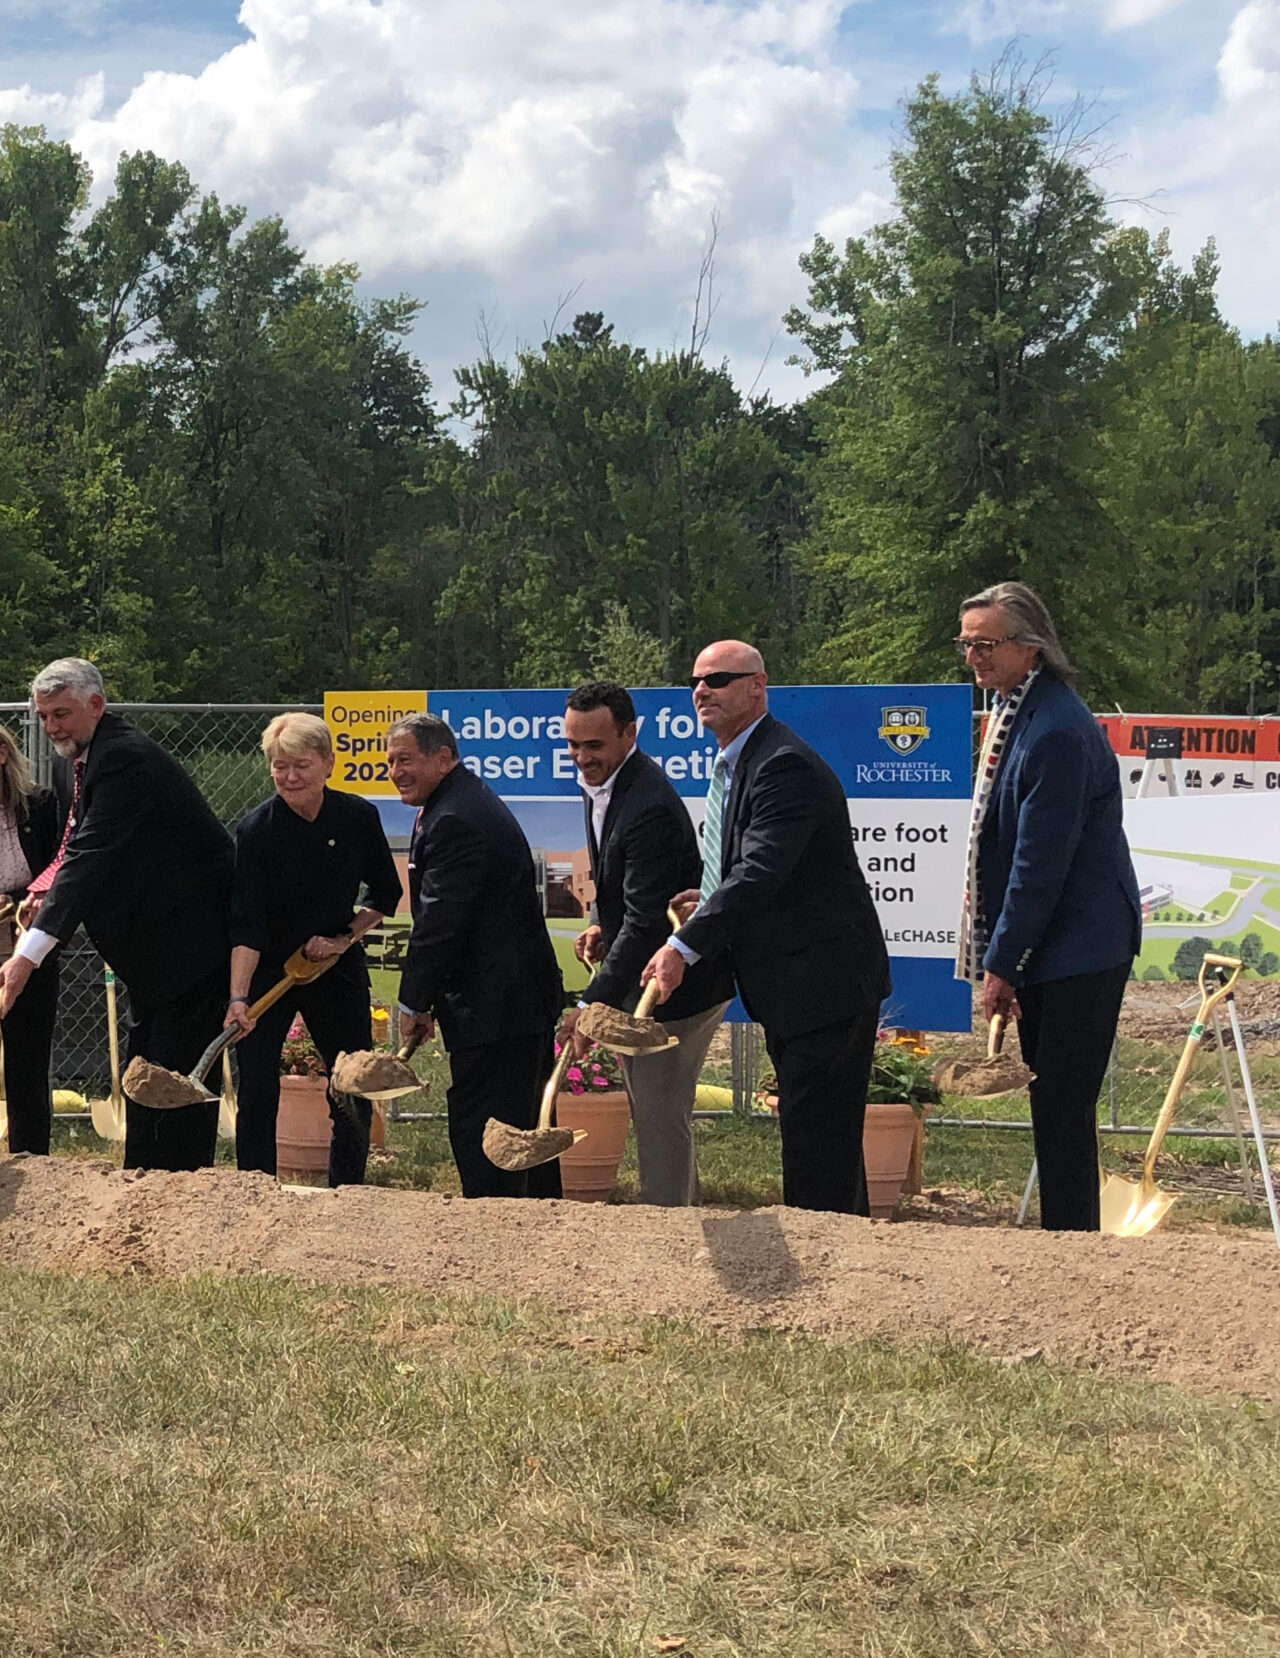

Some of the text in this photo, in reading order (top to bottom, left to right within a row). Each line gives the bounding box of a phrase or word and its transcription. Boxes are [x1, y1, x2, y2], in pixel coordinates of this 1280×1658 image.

[442, 709, 645, 740] Labora
[336, 732, 388, 757] Spri
[1130, 726, 1257, 755] ANTION
[344, 762, 389, 782] 202
[463, 755, 540, 779] aser
[856, 764, 952, 783] ROCHESTER
[895, 822, 948, 843] foot
[867, 852, 916, 873] and
